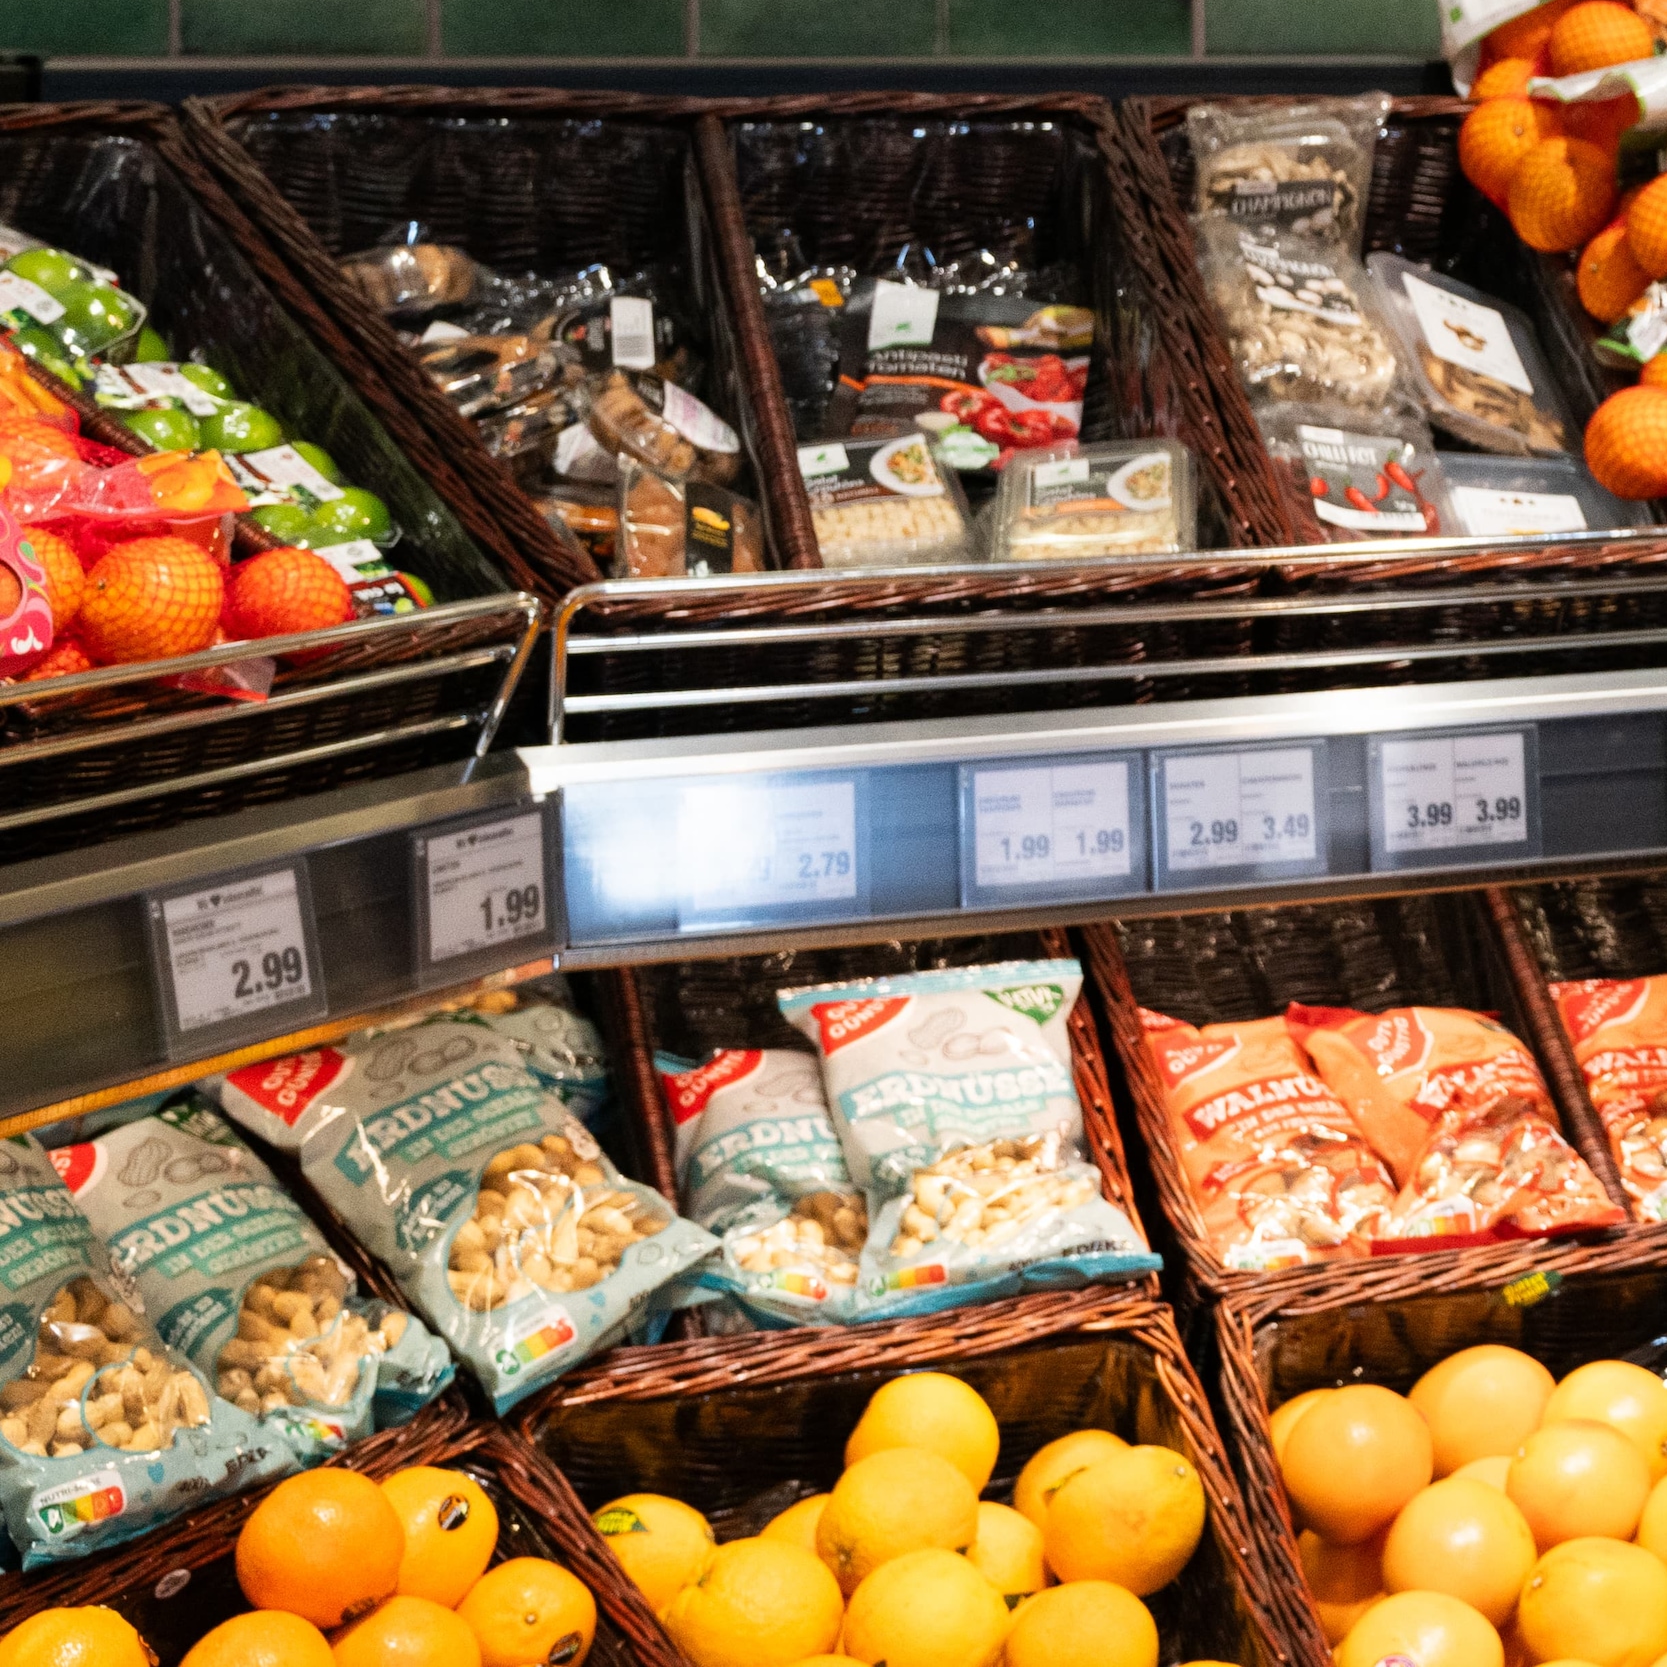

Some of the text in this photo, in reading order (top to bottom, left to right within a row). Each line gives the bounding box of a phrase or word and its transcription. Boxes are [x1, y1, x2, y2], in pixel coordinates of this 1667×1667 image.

[1407, 803, 1453, 830] 3.99
[1476, 797, 1521, 824] 3.99
[1190, 819, 1238, 846] 2.99
[1263, 813, 1309, 840] 3.49
[1001, 835, 1050, 862] 1.99
[1075, 829, 1124, 856] 1.99
[799, 851, 850, 879] 2.79
[481, 884, 539, 931] 1.99
[231, 946, 302, 998] 2.99
